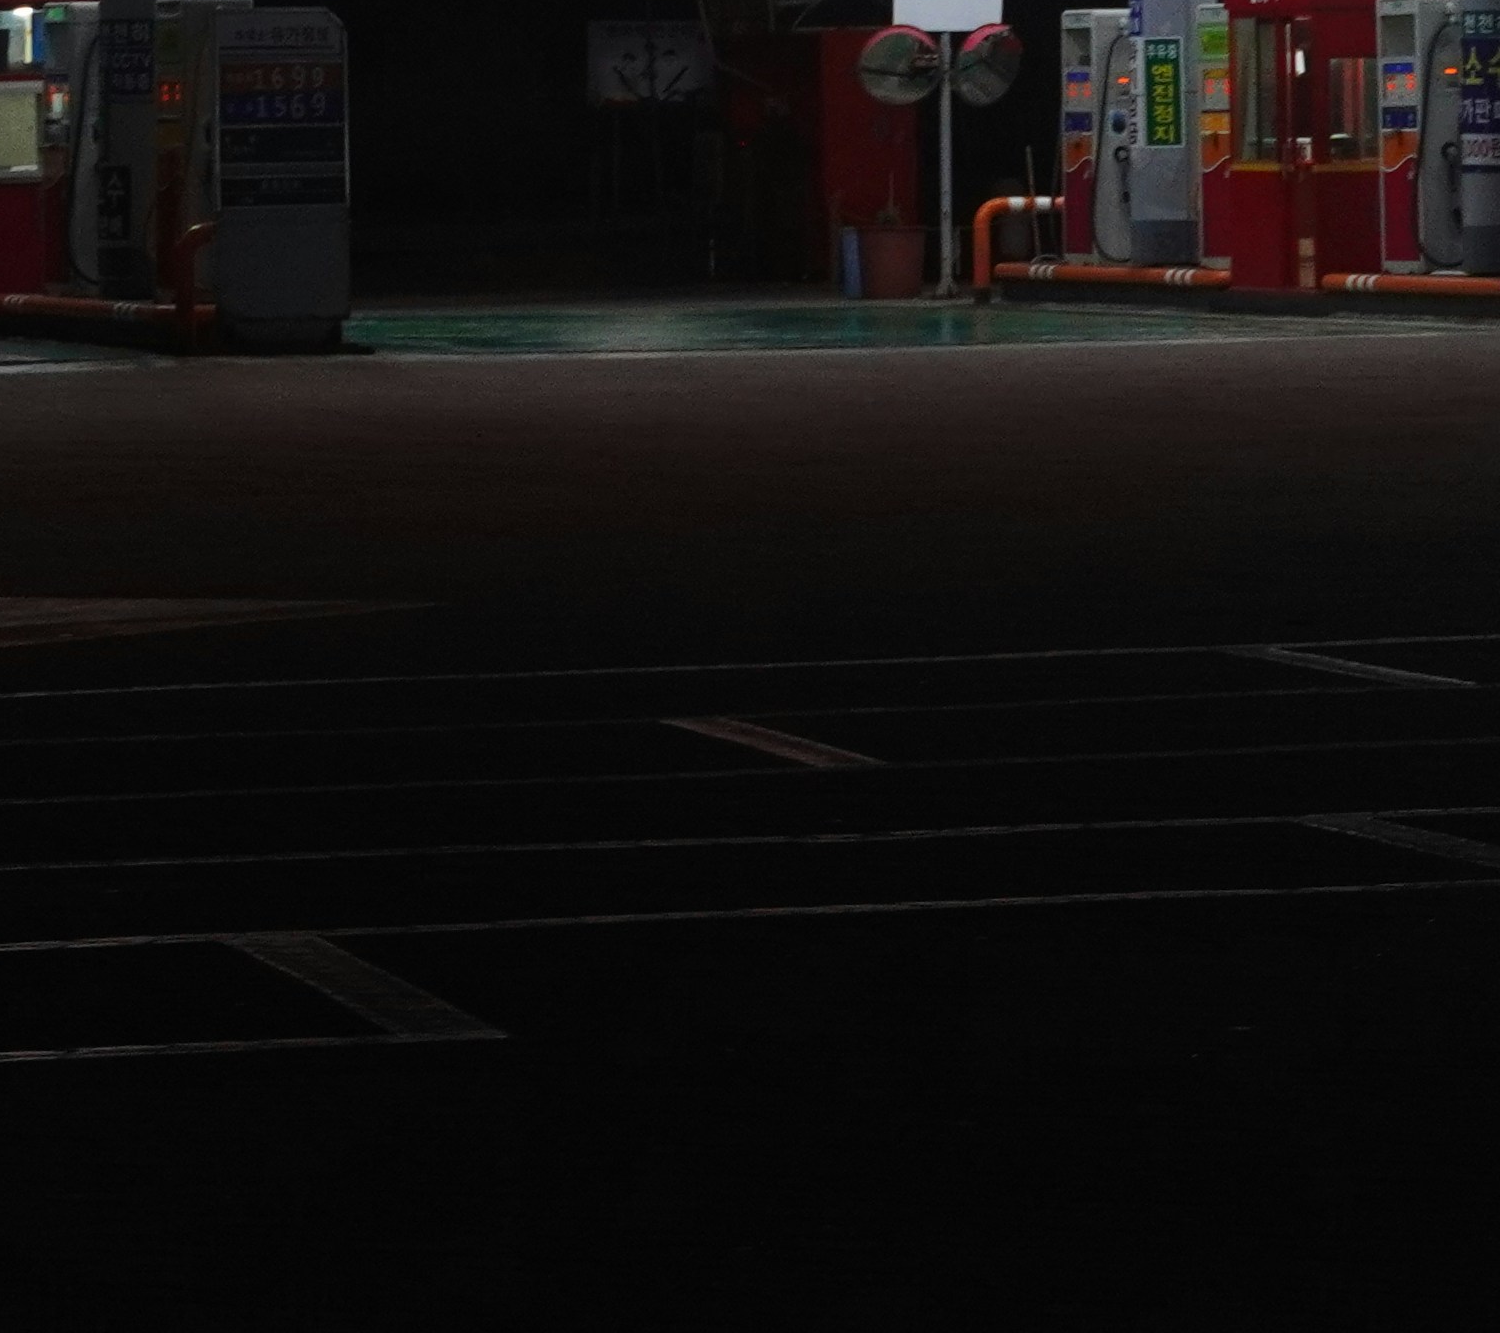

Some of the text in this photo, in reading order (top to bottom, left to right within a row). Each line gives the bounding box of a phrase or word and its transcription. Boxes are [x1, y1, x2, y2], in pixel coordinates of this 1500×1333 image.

[253, 65, 325, 90] 1699
[256, 92, 327, 119] 1569
[1151, 63, 1175, 143] 엔진정지
